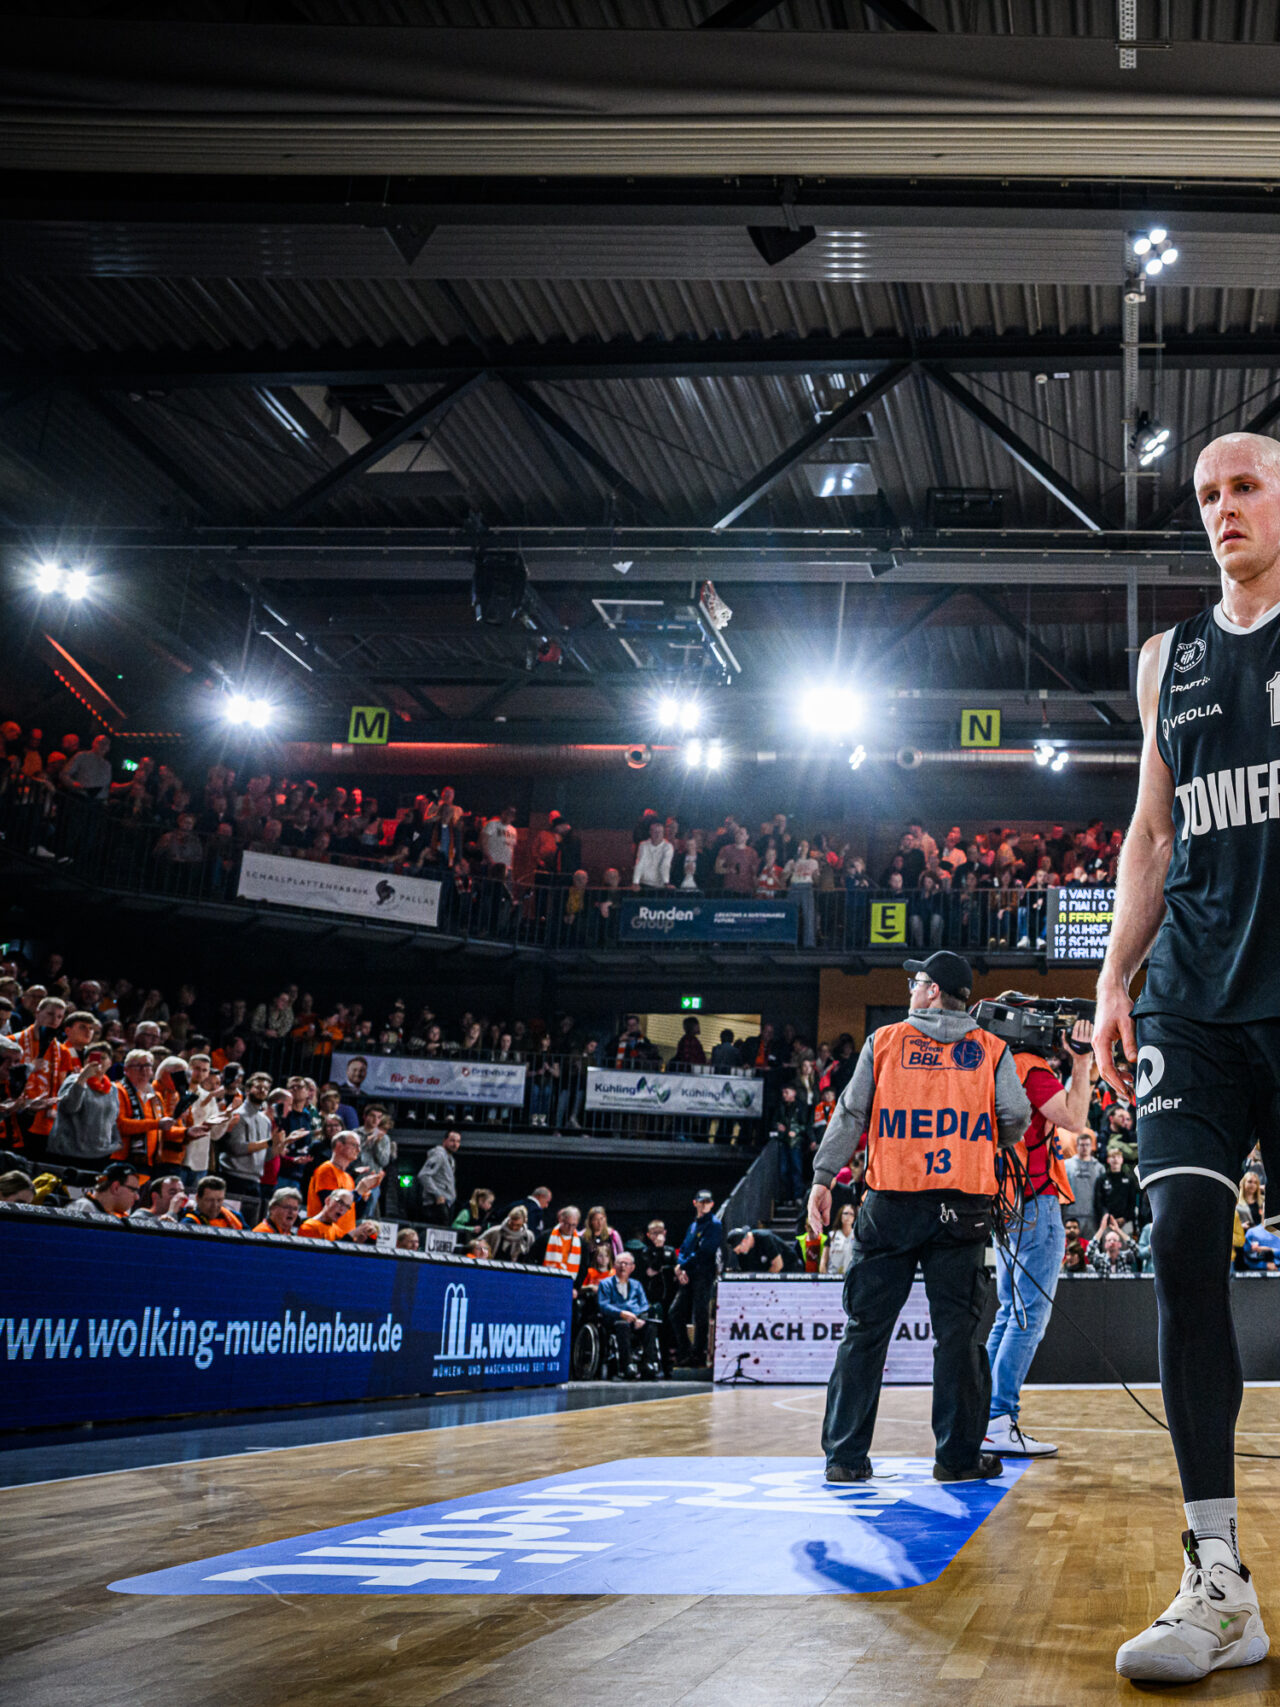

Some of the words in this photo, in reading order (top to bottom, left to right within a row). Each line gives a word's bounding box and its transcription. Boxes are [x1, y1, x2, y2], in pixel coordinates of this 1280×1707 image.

[1170, 678, 1203, 694] CRAFT
[353, 711, 387, 738] M
[1170, 703, 1223, 729] VEOLIA
[969, 714, 993, 741] N
[638, 906, 694, 921] Runden
[881, 905, 896, 929] E
[631, 917, 675, 933] Group
[1054, 948, 1067, 959] 17
[908, 1052, 943, 1066] BBL
[390, 1073, 404, 1083] für
[408, 1074, 425, 1084] Sie
[426, 1075, 441, 1085] da
[594, 1083, 637, 1096] Kühling
[878, 1107, 993, 1142] MEDIA
[924, 1148, 952, 1176] 13
[729, 1322, 806, 1341] MACH
[813, 1322, 845, 1341] DE
